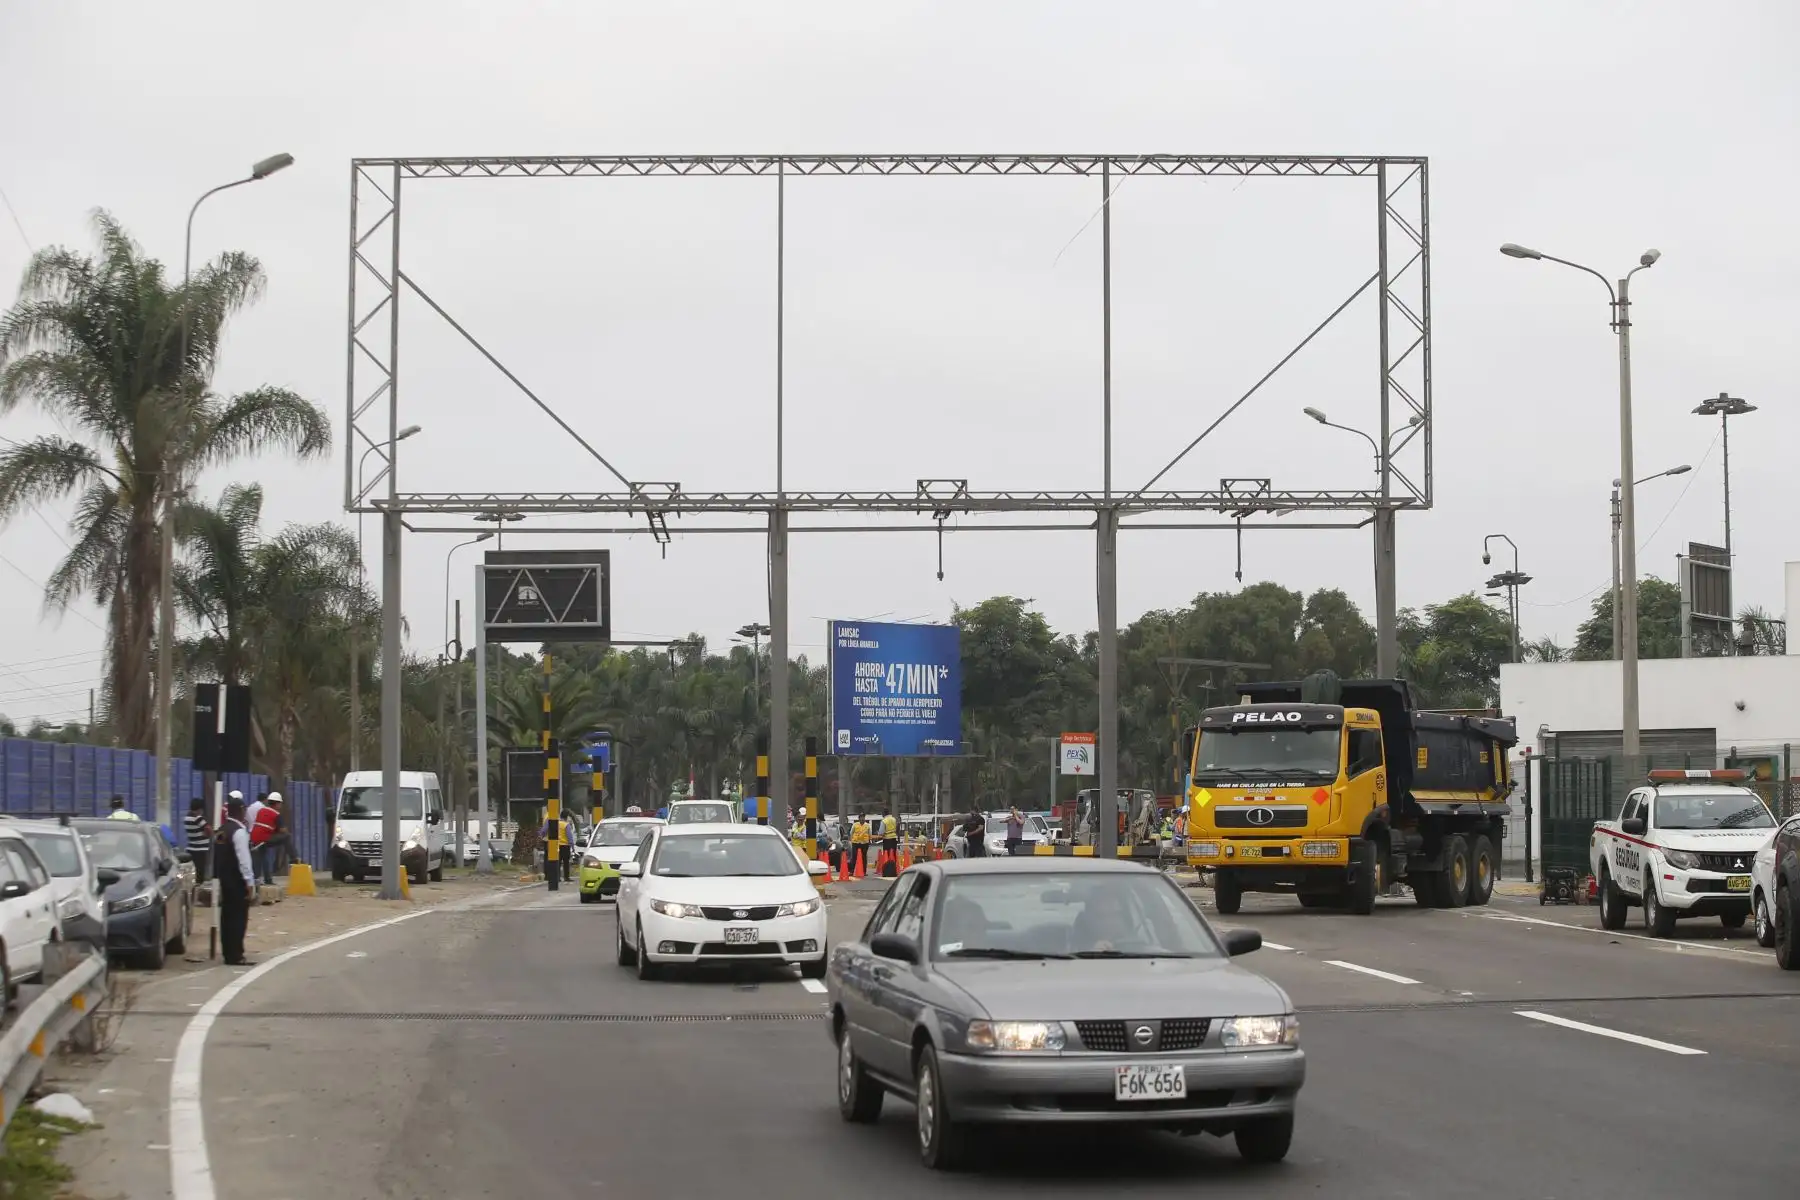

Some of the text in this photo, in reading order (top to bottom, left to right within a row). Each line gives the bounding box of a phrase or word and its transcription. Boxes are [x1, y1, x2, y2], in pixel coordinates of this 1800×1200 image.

[838, 627, 860, 638] LAMSAC
[855, 662, 885, 677] AHORRA
[855, 678, 878, 692] HASTA
[852, 697, 862, 706] DEL
[913, 699, 942, 708] AEROPUERTO
[921, 709, 936, 718] VUELO
[1232, 712, 1302, 723] PELAO
[1066, 749, 1080, 758] PEX
[1119, 1072, 1183, 1094] F6K-656
